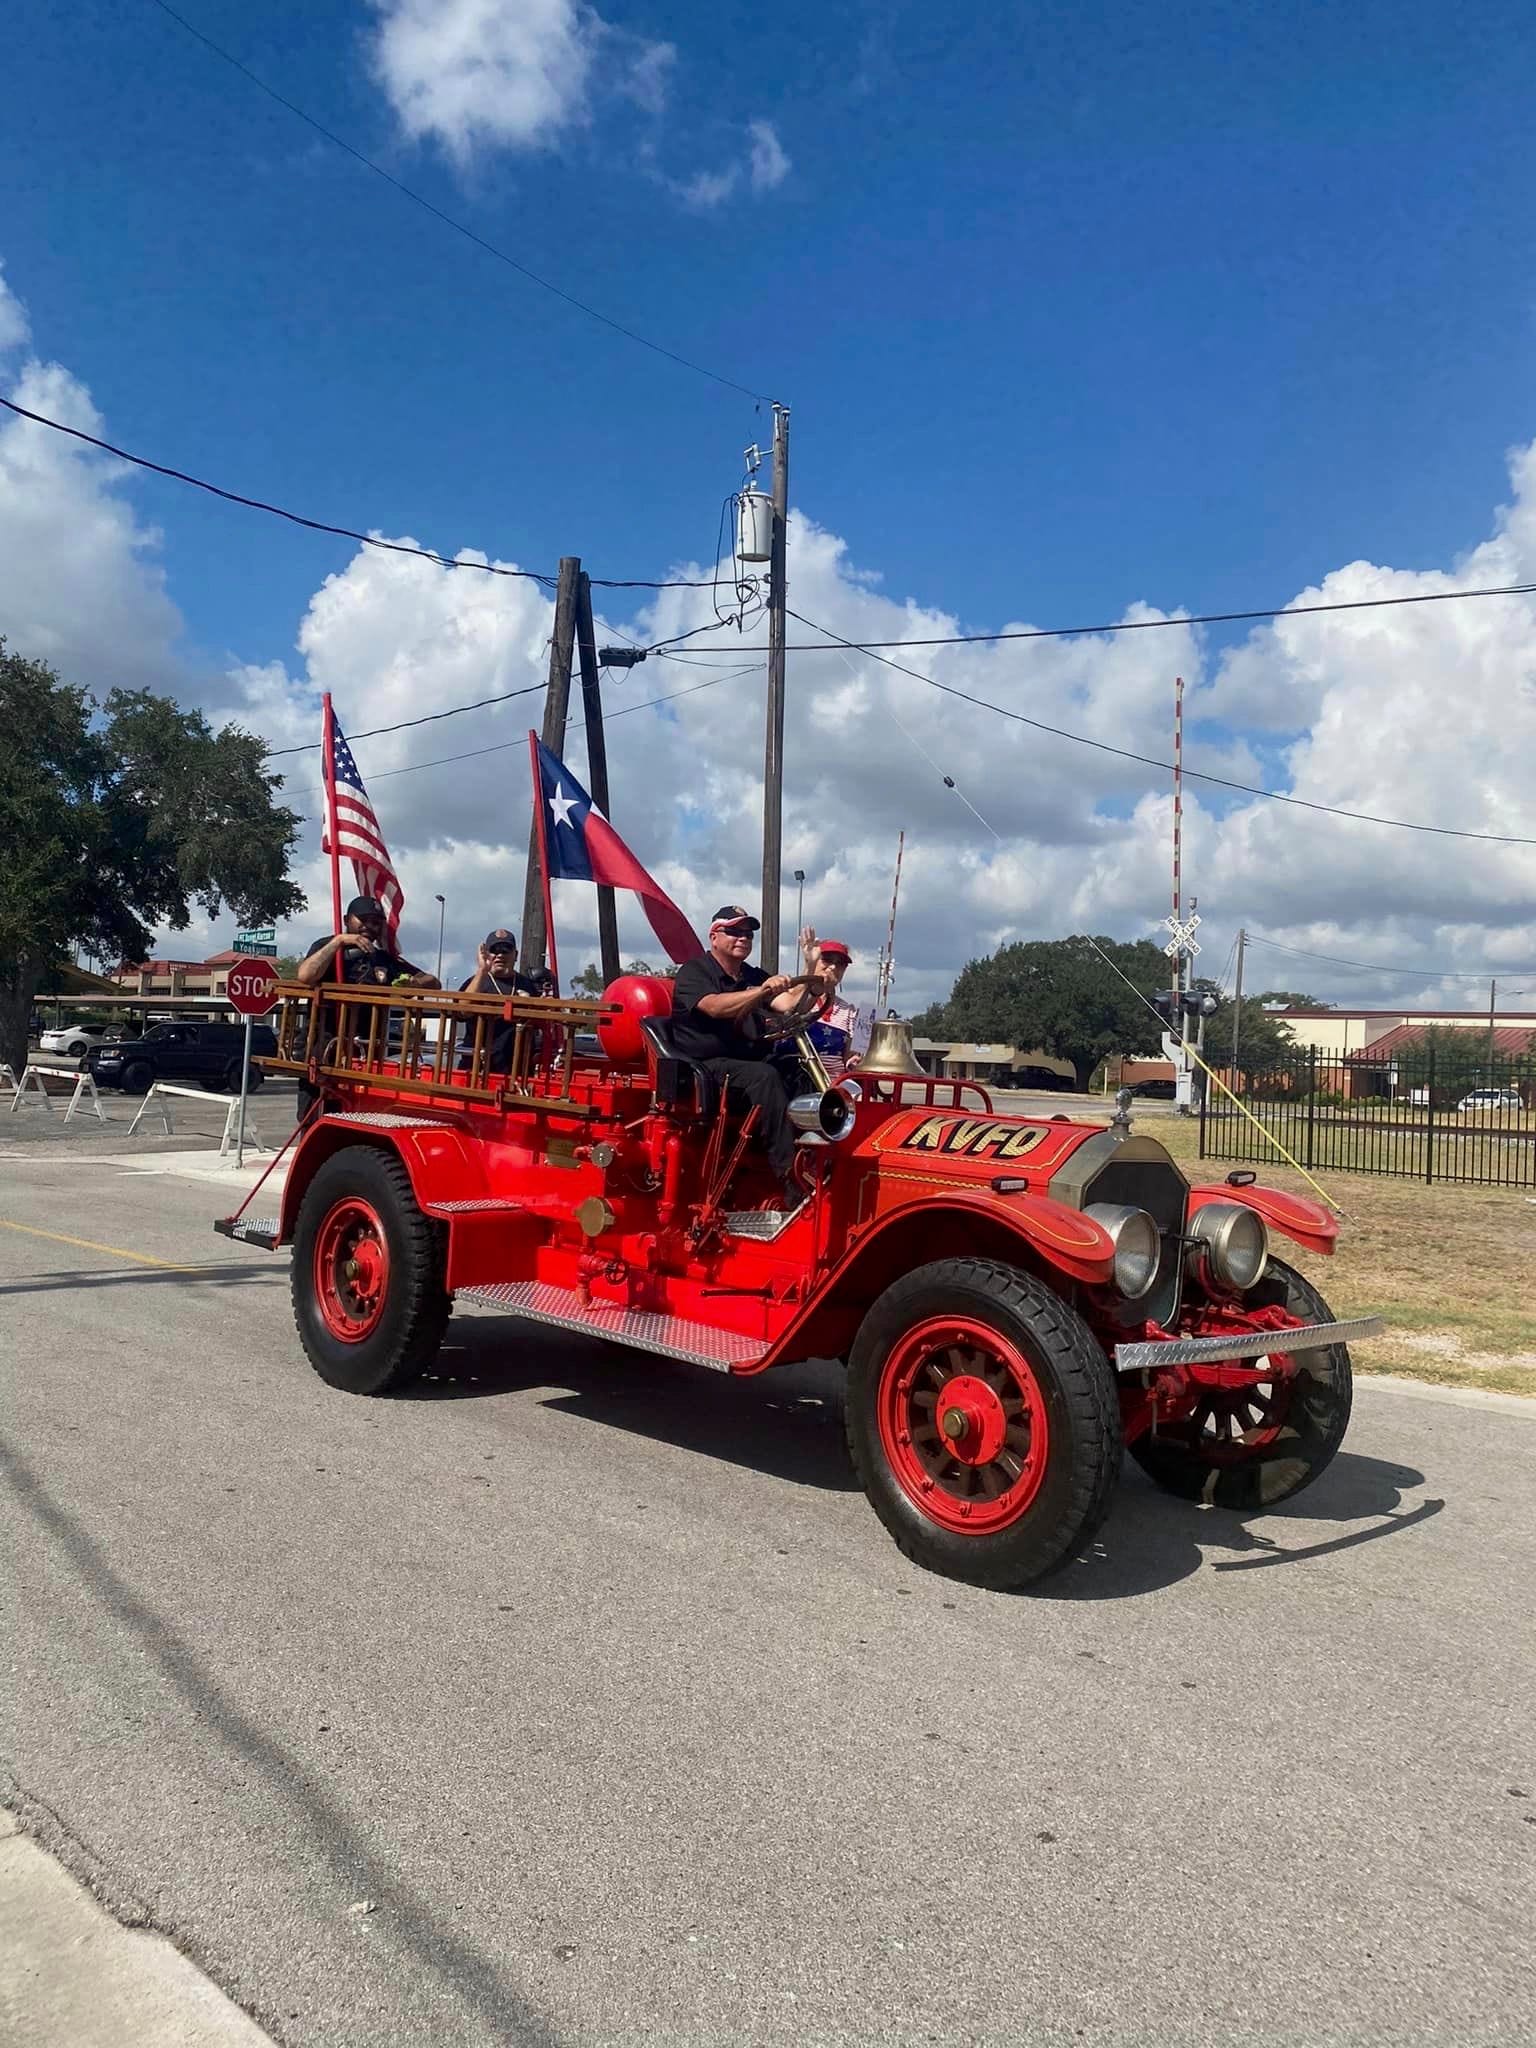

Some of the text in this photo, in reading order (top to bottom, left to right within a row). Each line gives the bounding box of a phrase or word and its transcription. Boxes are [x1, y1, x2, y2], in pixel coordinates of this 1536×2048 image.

[1167, 918, 1200, 954] RAIL ROAD
[903, 1116, 1050, 1158] KVFD
